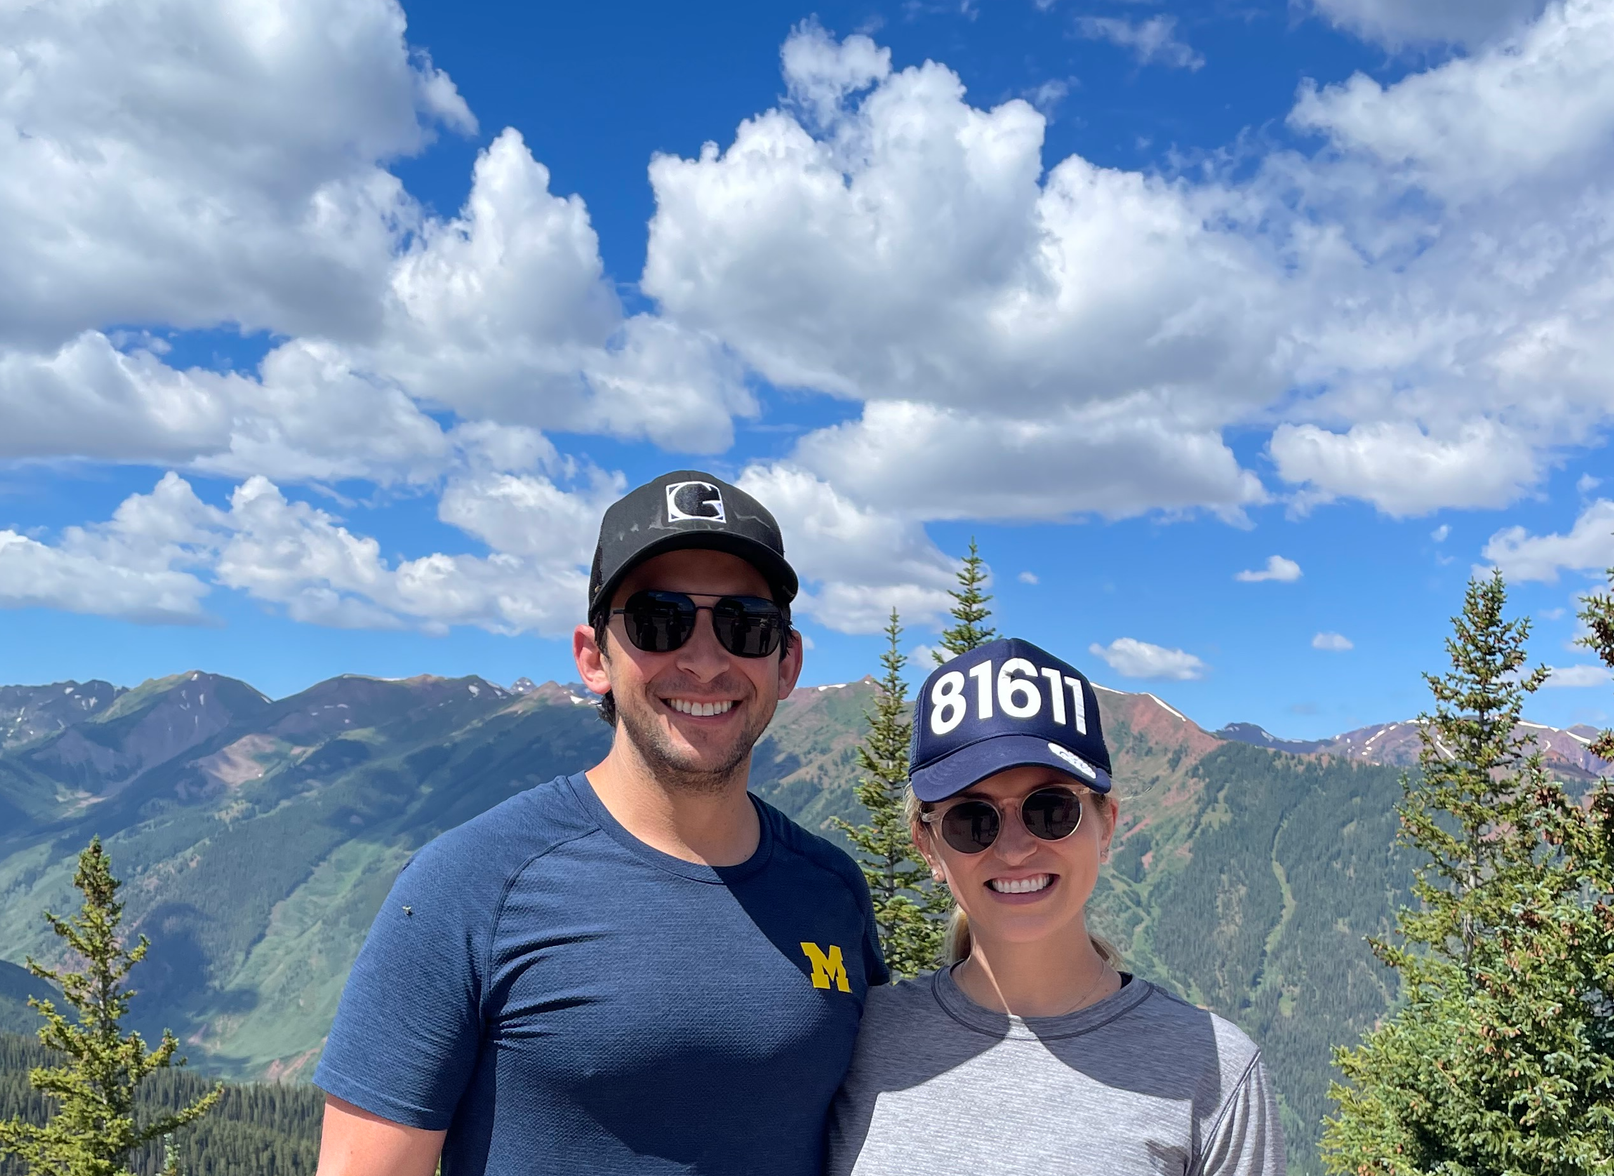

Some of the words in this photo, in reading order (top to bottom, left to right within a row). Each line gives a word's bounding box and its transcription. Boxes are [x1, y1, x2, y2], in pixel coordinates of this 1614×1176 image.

[666, 481, 725, 523] G
[930, 657, 1087, 736] 81611
[800, 941, 852, 993] M
